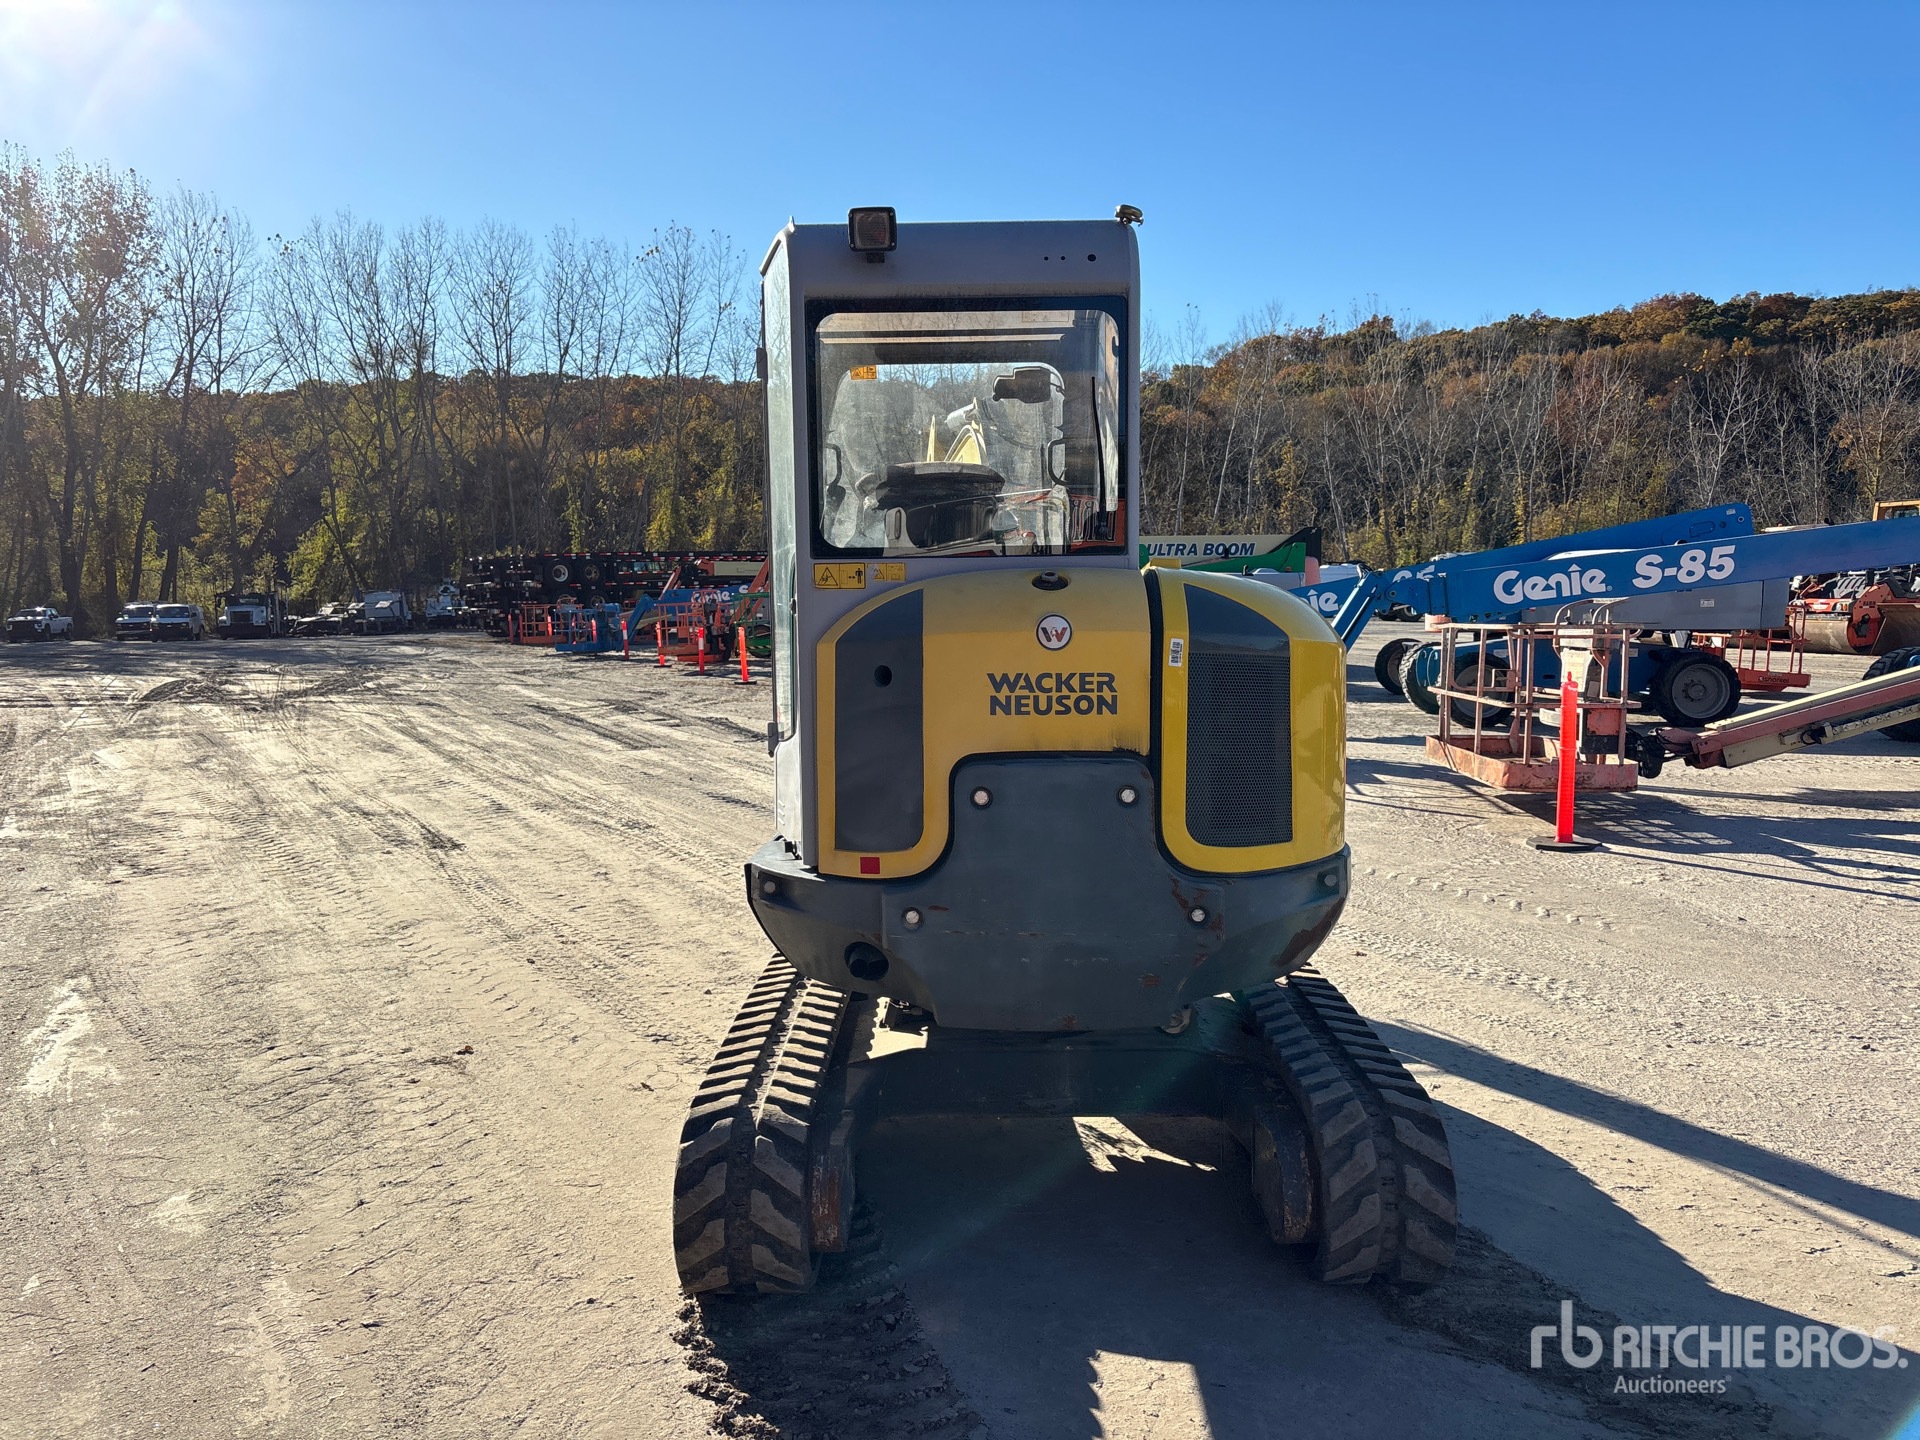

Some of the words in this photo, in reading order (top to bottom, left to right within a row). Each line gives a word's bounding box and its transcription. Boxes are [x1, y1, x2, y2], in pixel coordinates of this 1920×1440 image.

[1147, 543, 1198, 556] ULTRA
[1203, 542, 1256, 556] BOOM
[1493, 563, 1606, 604] Genie
[1632, 545, 1736, 588] S-85
[986, 672, 1118, 693] WACKER
[989, 695, 1118, 715] NEUSON
